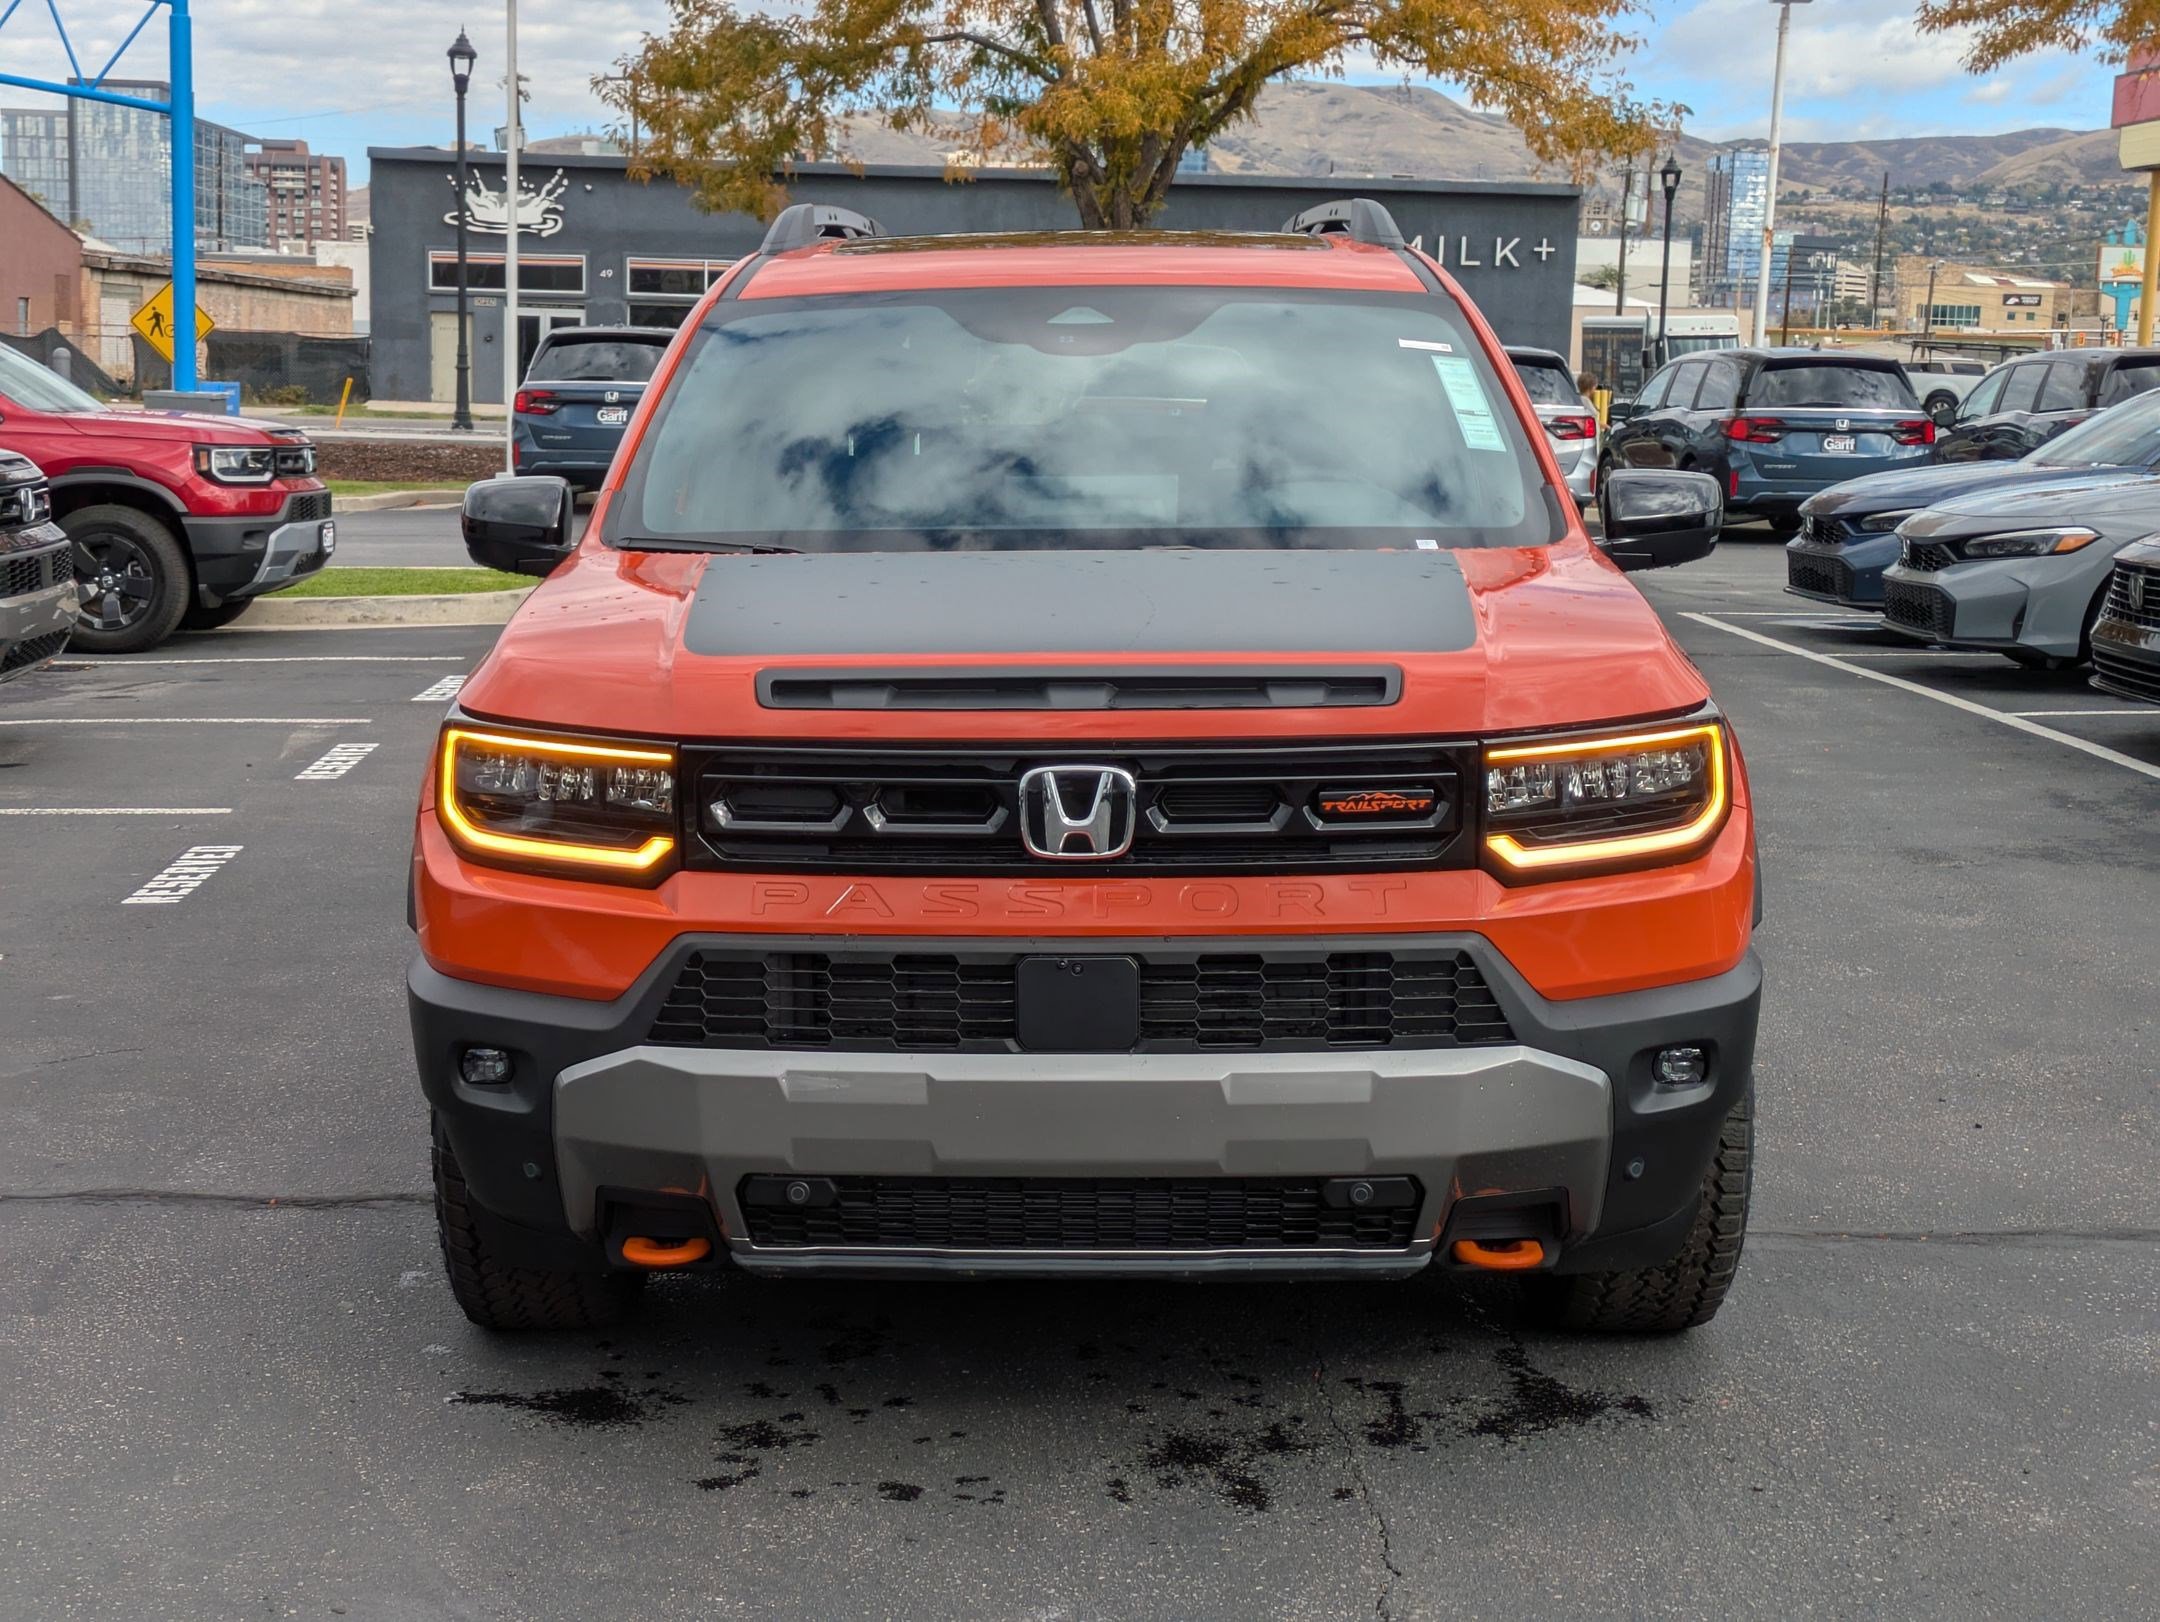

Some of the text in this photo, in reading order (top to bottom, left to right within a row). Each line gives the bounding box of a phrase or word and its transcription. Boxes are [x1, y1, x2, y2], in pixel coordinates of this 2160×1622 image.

[599, 269, 613, 278] 49
[597, 409, 628, 422] Garff
[1823, 437, 1856, 450] Garff
[293, 742, 380, 780] RESERVED
[1321, 799, 1431, 812] TRAILSPORT
[121, 845, 244, 904] RESERVED
[750, 880, 1408, 919] PASSPORT
